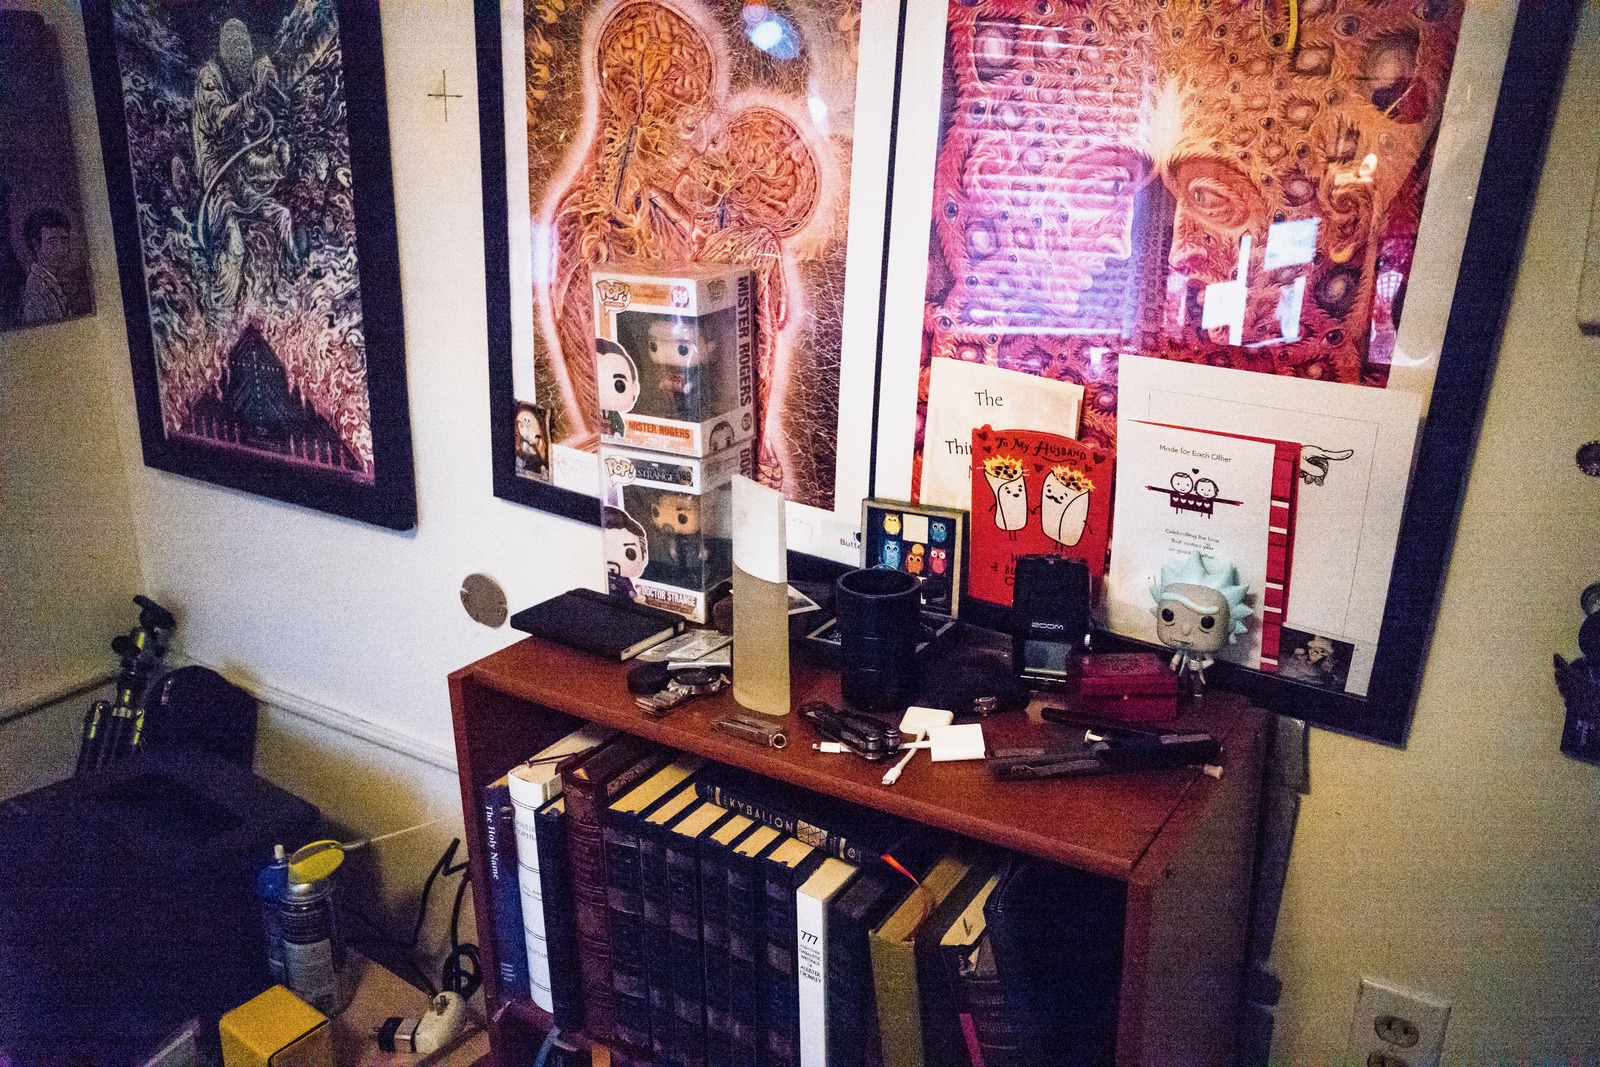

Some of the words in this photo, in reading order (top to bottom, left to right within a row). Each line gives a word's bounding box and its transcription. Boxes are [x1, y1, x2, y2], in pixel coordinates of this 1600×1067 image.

[596, 280, 630, 302] POP!
[738, 276, 750, 338] MISTER
[739, 342, 751, 407] ROGERS
[974, 389, 1003, 406] The
[628, 421, 657, 433] MISTER
[660, 424, 691, 439] ROGERS
[996, 437, 1008, 449] To
[1011, 437, 1029, 454] My
[1159, 444, 1178, 453] Made
[1180, 447, 1190, 455] for
[1192, 450, 1210, 459] Each
[604, 457, 634, 479] POP!
[640, 585, 666, 601] DOCTOR
[667, 591, 697, 608] STRANGE
[485, 805, 494, 824] The
[729, 797, 794, 833] KYBALION
[487, 825, 497, 850] Holy
[490, 851, 499, 880] Name
[800, 929, 819, 946] 777
